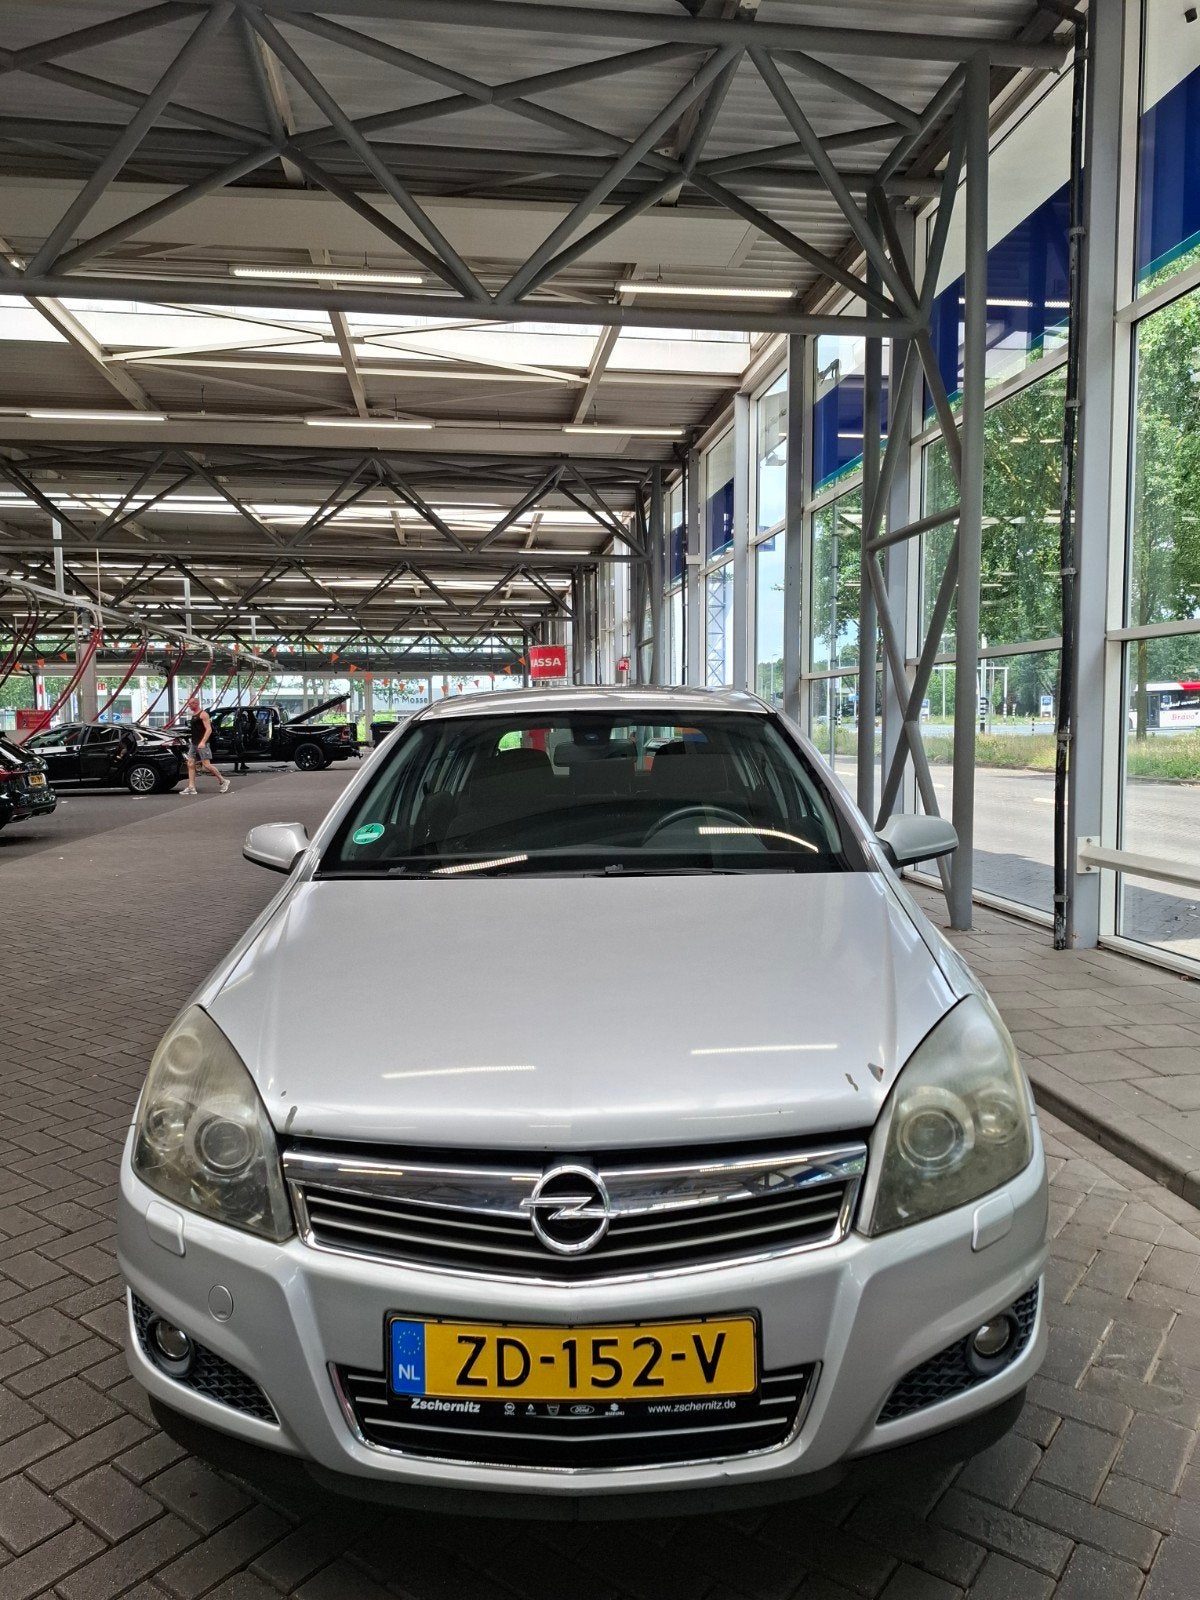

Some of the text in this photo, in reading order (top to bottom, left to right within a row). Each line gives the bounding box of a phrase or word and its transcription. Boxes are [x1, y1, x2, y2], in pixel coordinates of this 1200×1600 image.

[401, 695, 428, 704] Mosse
[365, 824, 375, 834] 4
[456, 1333, 727, 1388] ZD-152-V
[398, 1363, 421, 1382] NL
[410, 1397, 481, 1413] Zschernitz
[647, 1399, 737, 1414] www.zschernitz.de
